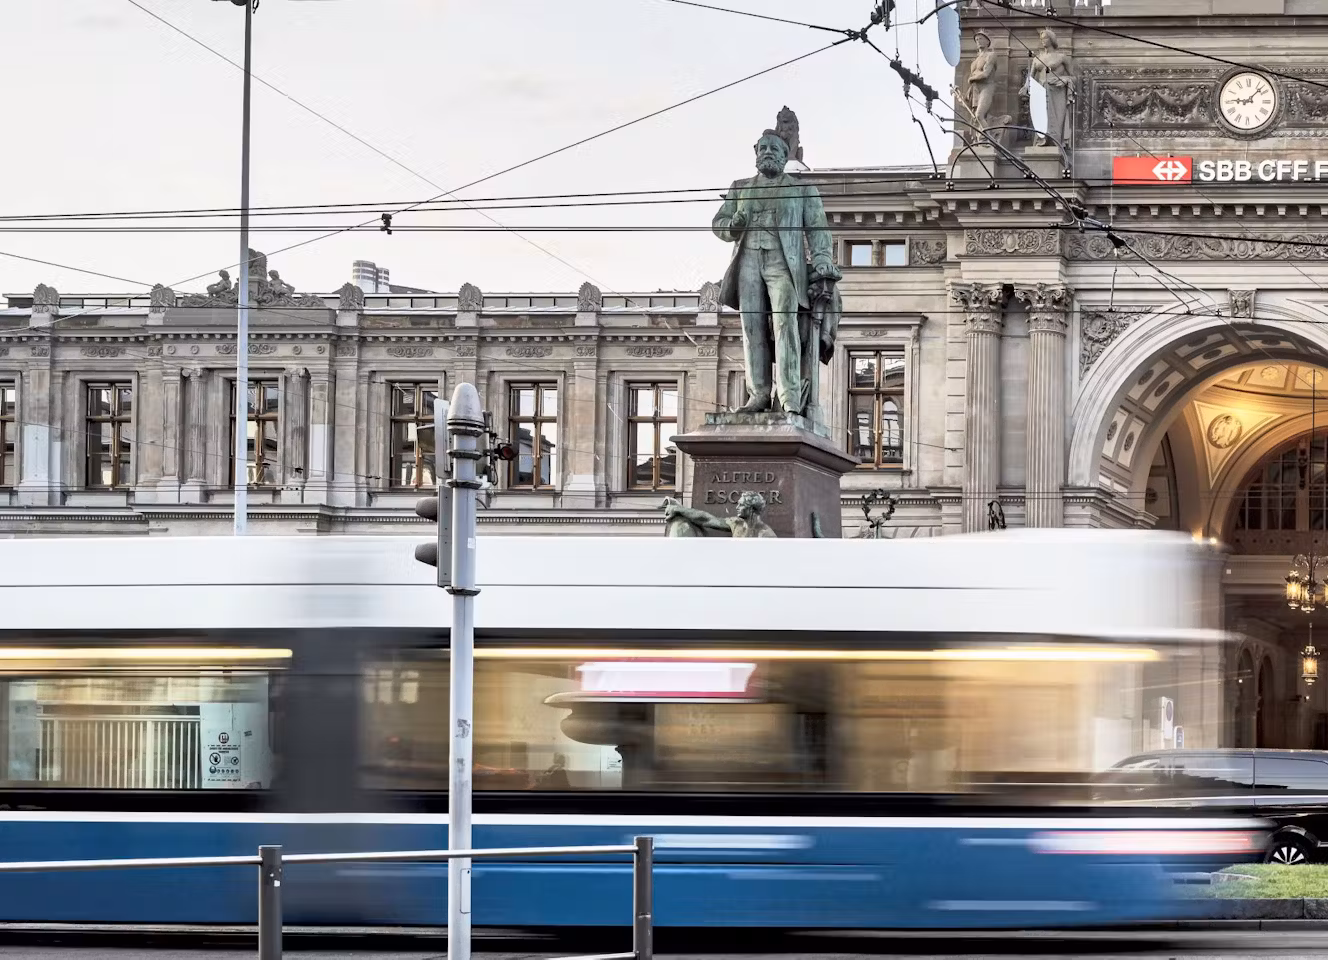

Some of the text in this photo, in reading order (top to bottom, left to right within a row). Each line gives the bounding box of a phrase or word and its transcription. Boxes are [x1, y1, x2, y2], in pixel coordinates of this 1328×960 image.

[1199, 160, 1252, 181] SBB
[1258, 159, 1308, 181] CFF
[711, 471, 777, 483] ALFRED
[704, 489, 782, 504] ESCR
